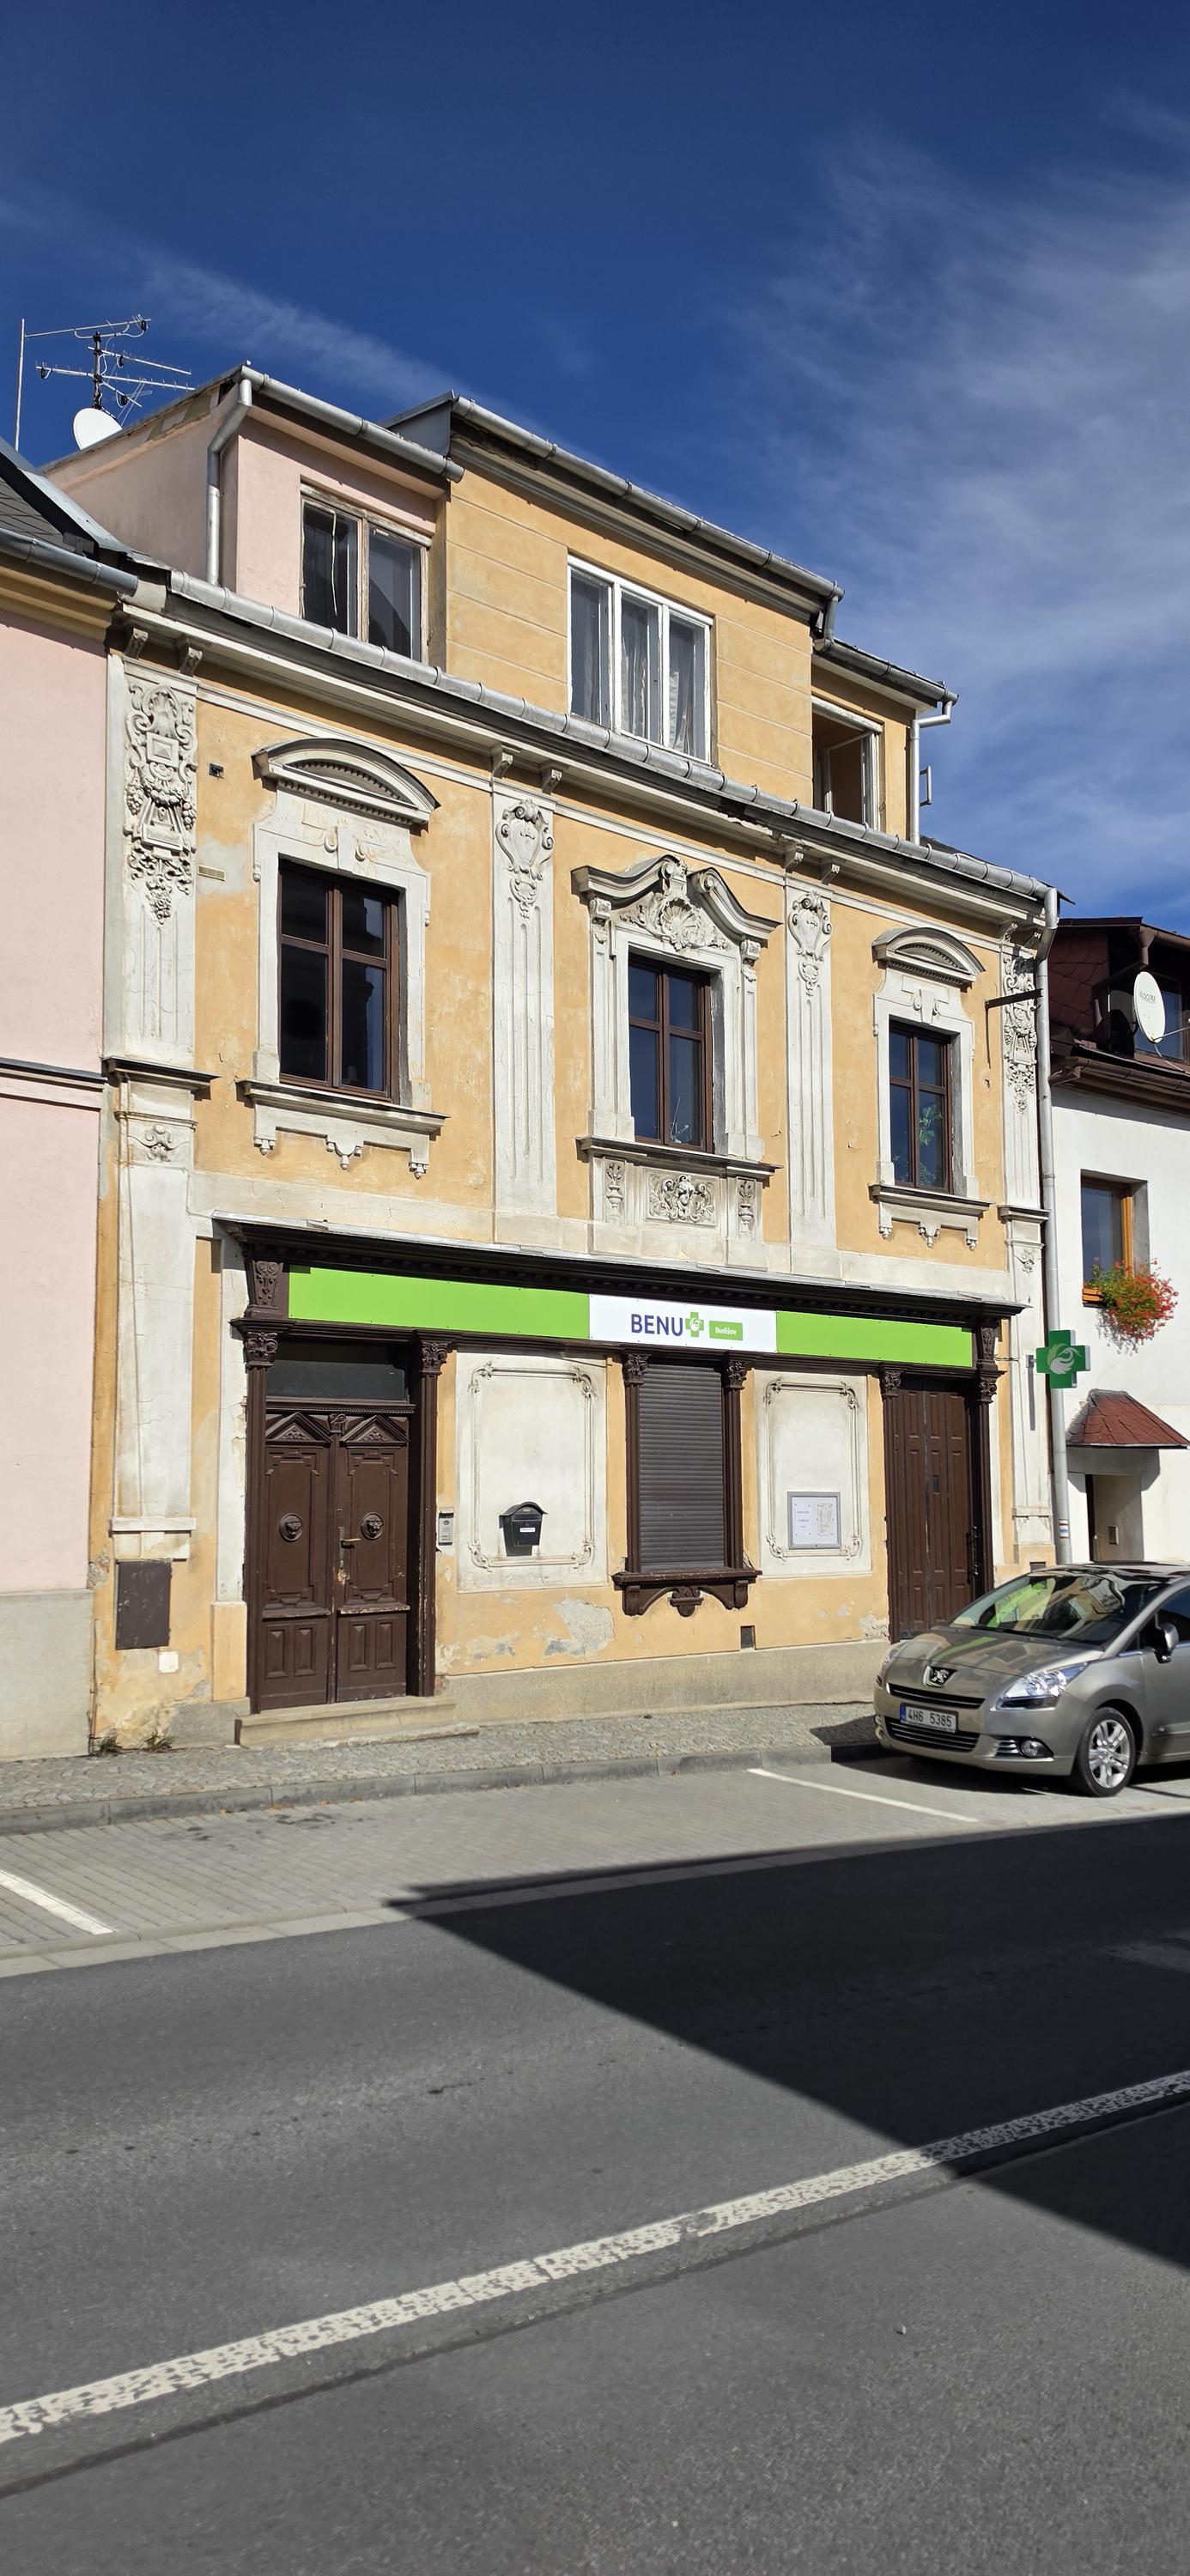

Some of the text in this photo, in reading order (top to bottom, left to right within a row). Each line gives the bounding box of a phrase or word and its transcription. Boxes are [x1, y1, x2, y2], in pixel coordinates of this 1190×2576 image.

[631, 1313, 683, 1336] BENU
[714, 1326, 737, 1335] Budišov
[908, 1709, 952, 1728] 4H6 5385
